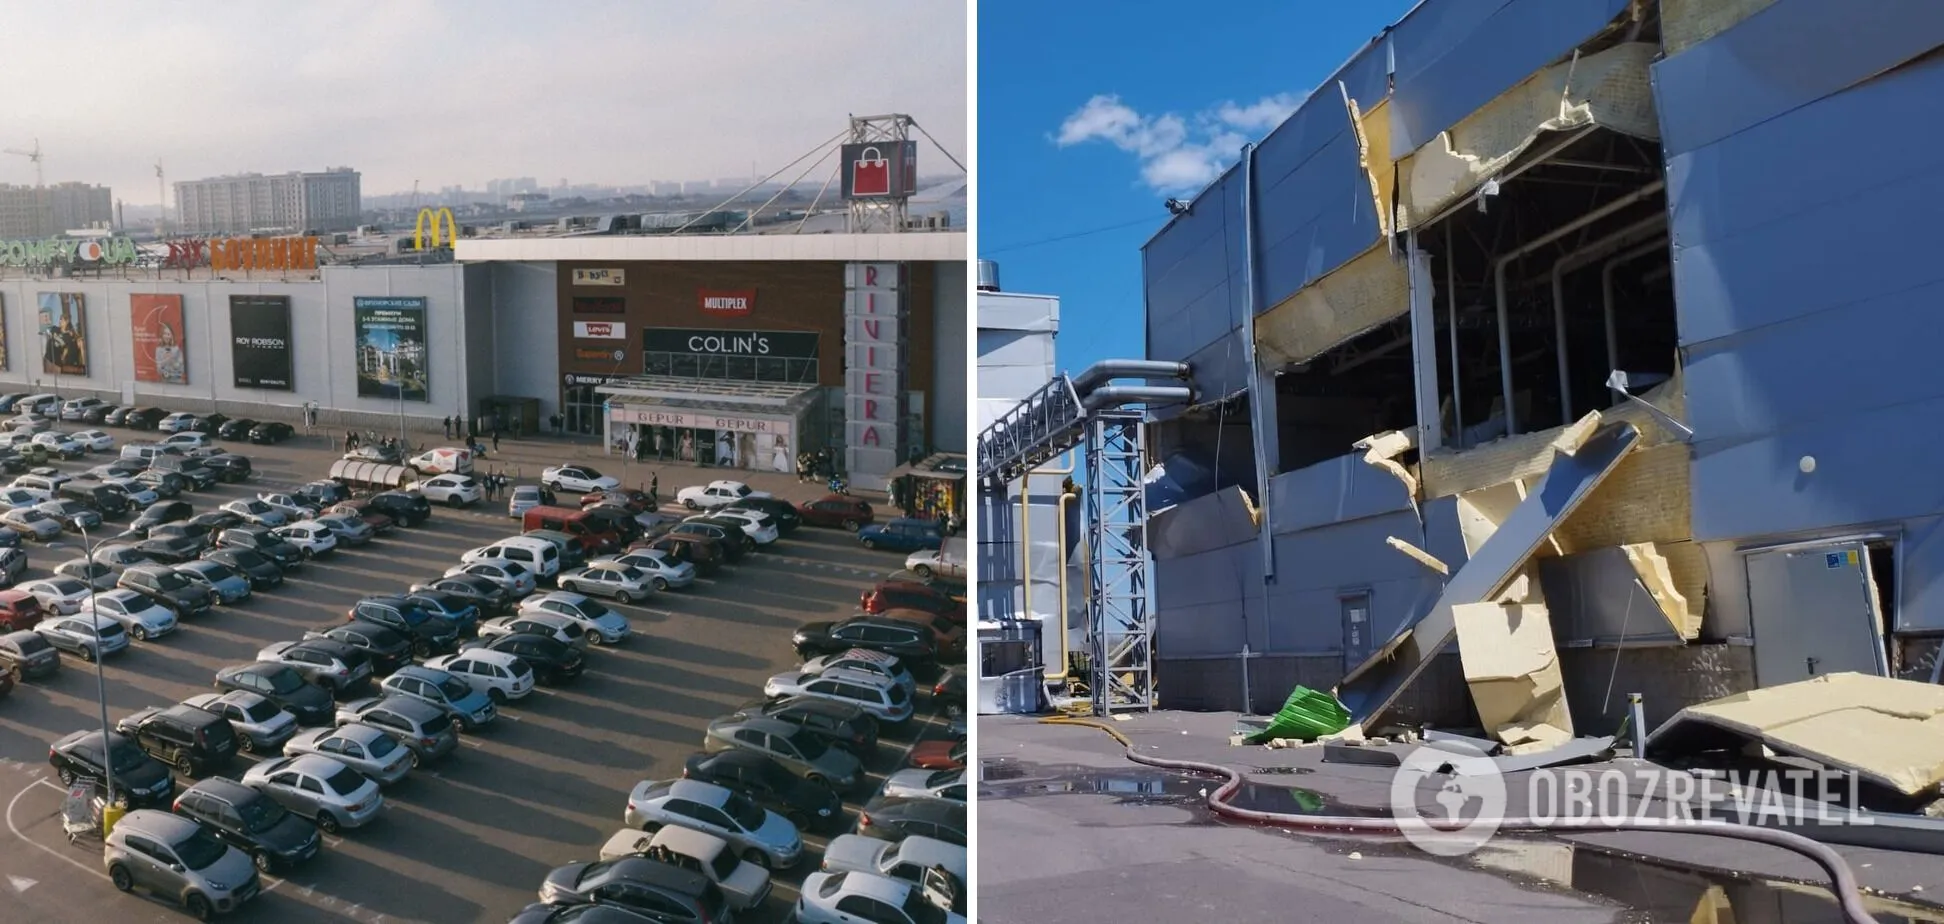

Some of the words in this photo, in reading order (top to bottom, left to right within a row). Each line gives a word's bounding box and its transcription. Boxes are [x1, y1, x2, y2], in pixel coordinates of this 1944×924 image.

[704, 297, 747, 310] MULTIPLEX
[236, 337, 249, 345] ROY
[688, 331, 770, 354] COLIN'S
[863, 265, 881, 447] RIVIERA
[576, 375, 603, 384] MERRY
[638, 412, 685, 425] GEPUR
[715, 418, 767, 431] GEPUR
